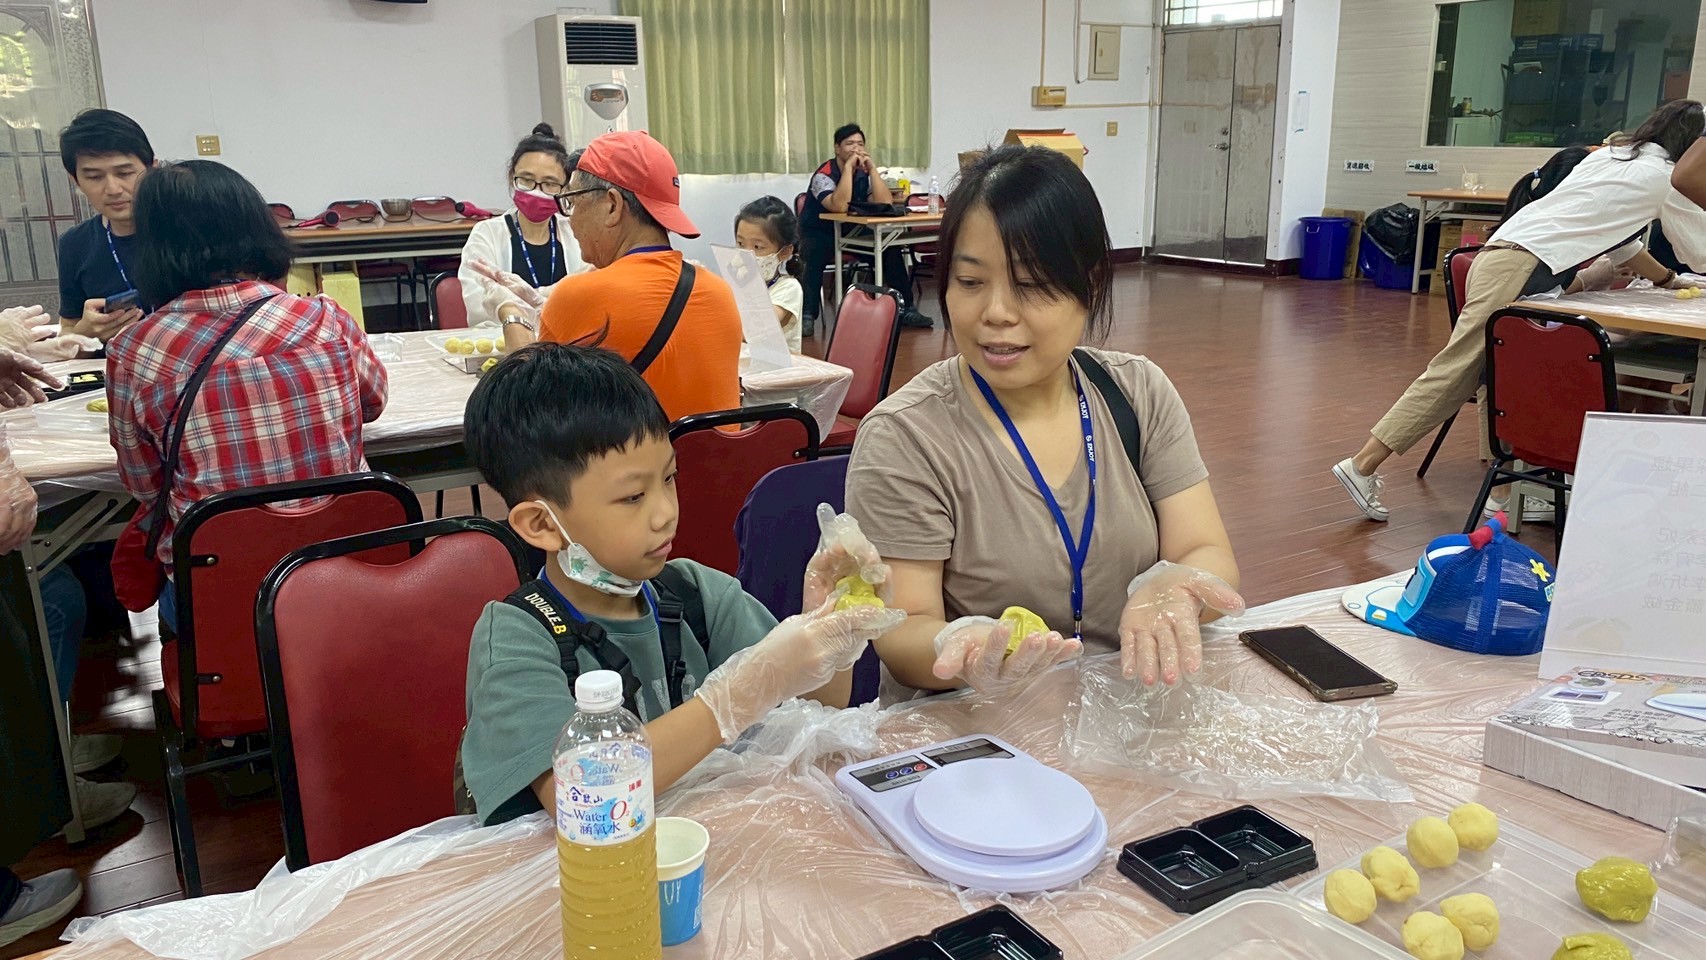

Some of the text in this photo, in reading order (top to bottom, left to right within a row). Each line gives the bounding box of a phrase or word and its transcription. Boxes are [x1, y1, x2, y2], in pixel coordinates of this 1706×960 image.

[1080, 402, 1089, 418] ENJOY
[1087, 442, 1095, 461] ENJOY
[573, 808, 607, 822] Water
